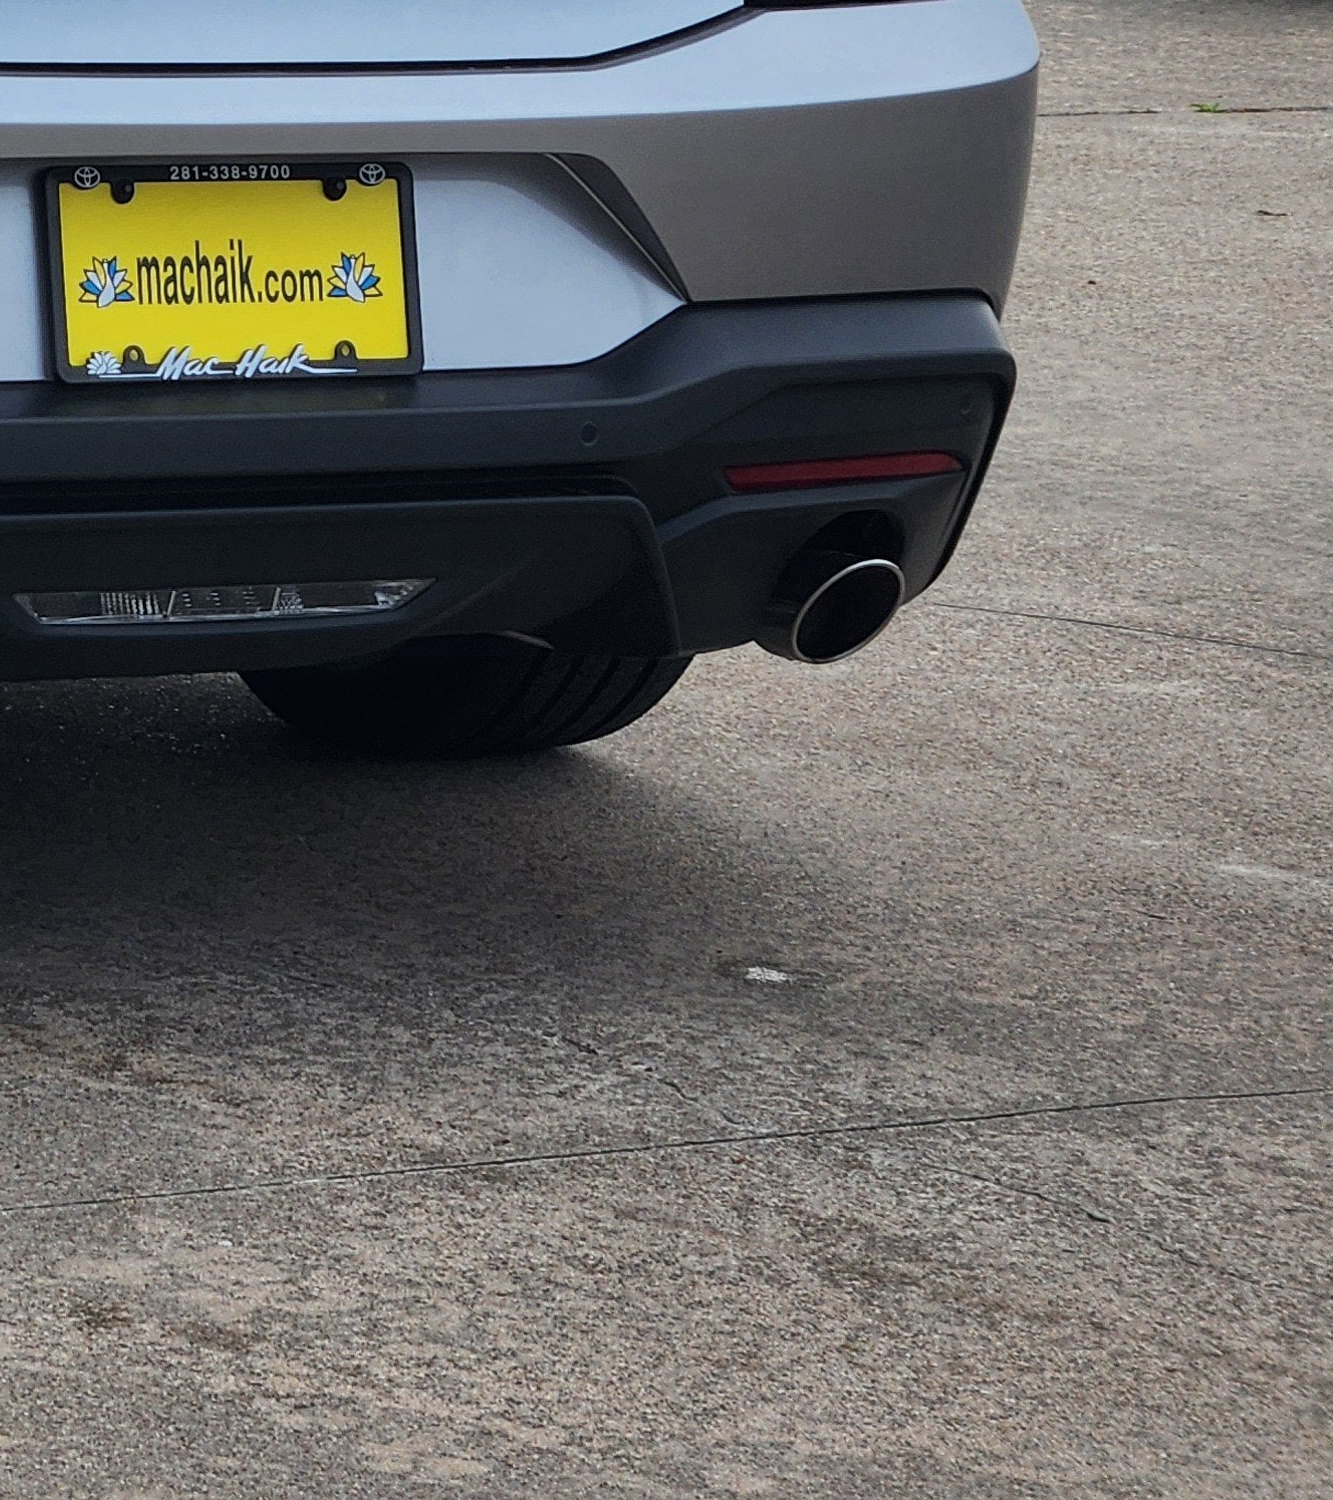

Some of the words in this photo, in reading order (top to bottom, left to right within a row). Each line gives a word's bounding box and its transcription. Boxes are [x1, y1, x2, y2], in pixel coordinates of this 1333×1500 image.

[169, 164, 291, 181] 281-338-9700
[136, 238, 324, 306] machaik.com
[154, 345, 234, 381] Mac
[235, 344, 359, 378] Haik
